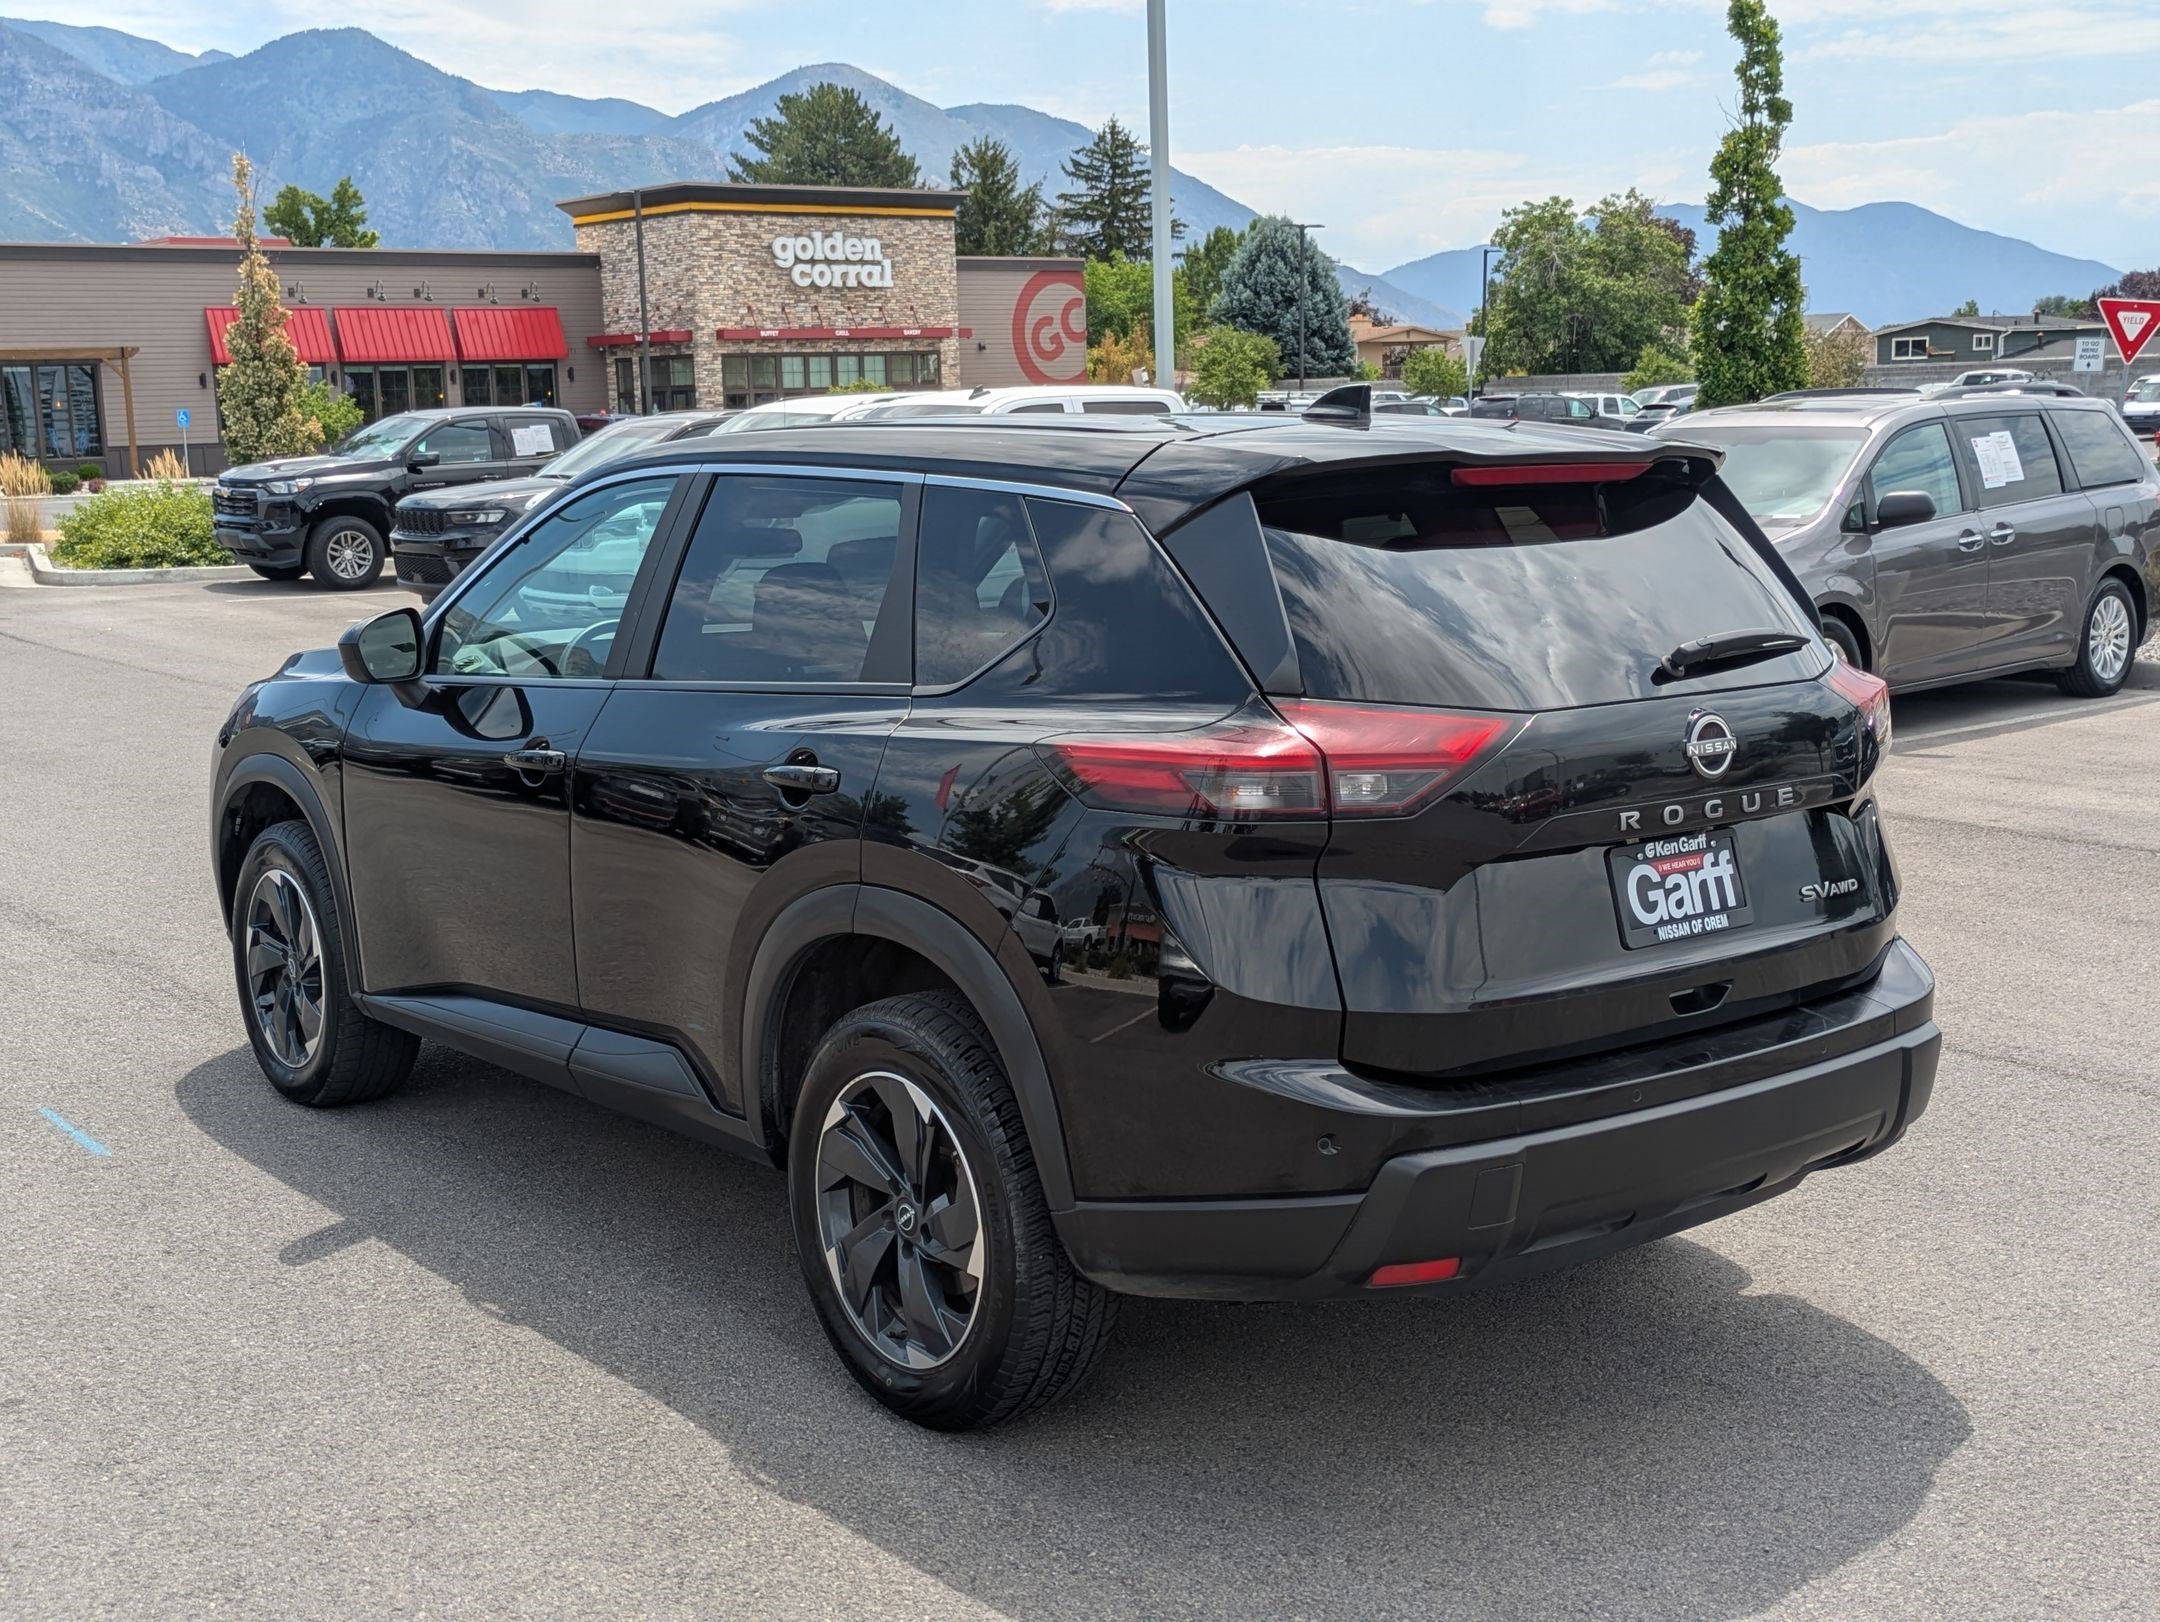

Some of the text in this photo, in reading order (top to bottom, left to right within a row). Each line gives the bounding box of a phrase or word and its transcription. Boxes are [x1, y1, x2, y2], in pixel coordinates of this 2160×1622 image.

[772, 231, 883, 268] golden
[791, 259, 894, 287] corral
[2122, 316, 2145, 325] YIELD
[1688, 739, 1737, 755] NISSAN
[1619, 786, 1795, 832] ROGUE
[1655, 840, 1679, 857] Ken
[1678, 833, 1707, 853] Garff
[1662, 863, 1672, 871] WE
[1672, 860, 1686, 869] HEAR
[1627, 849, 1737, 925] Garff
[1801, 878, 1858, 902] SV AWD
[1658, 913, 1729, 941] NISSAN OF OREM
